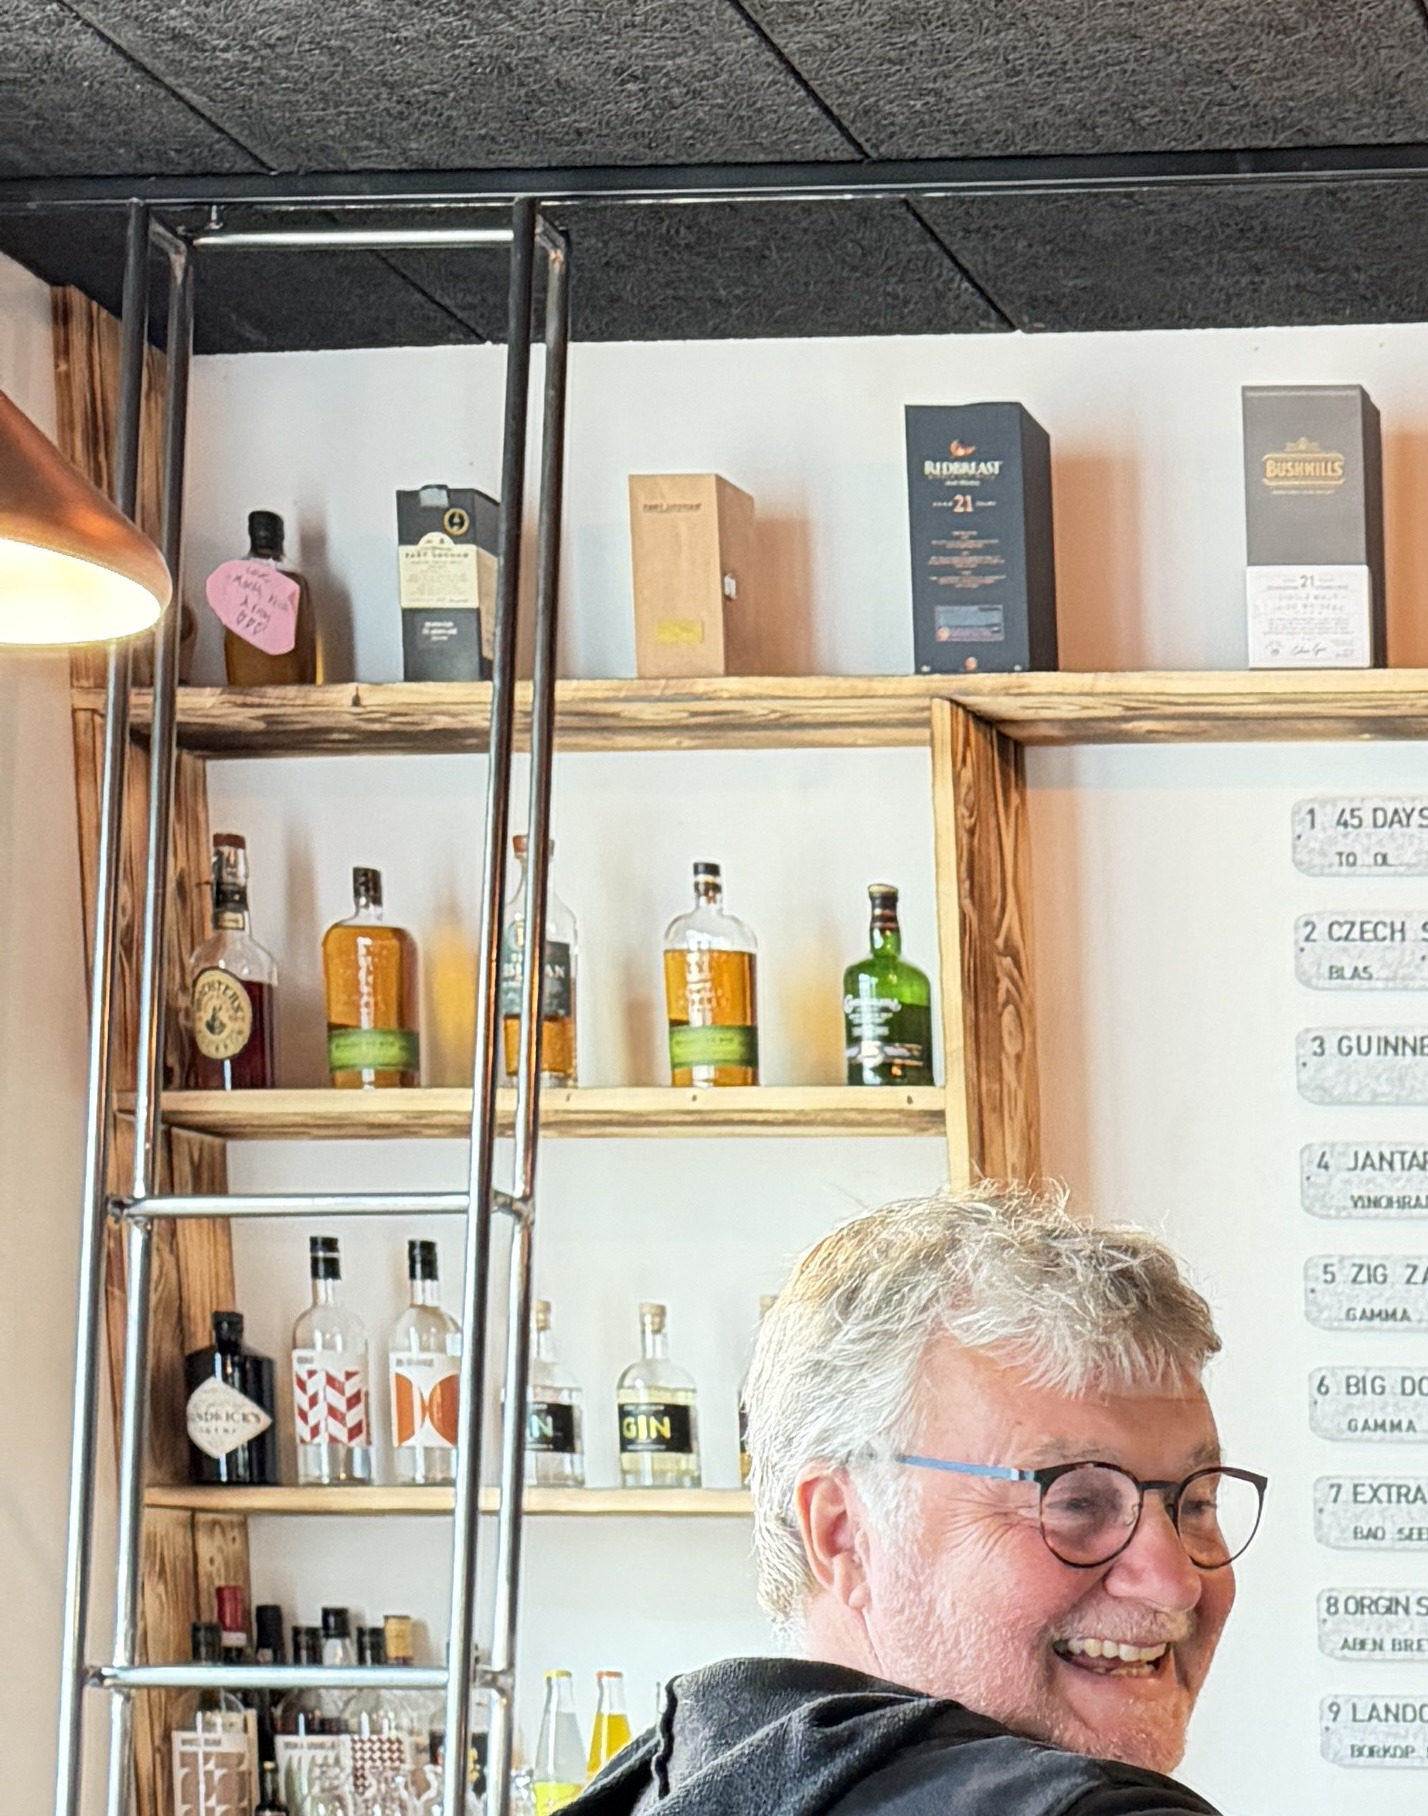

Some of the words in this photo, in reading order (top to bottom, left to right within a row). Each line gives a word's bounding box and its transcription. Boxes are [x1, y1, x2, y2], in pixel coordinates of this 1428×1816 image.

[952, 494, 974, 513] 21
[1300, 574, 1315, 588] 21
[1306, 807, 1316, 830] 1
[1335, 807, 1363, 830] 45
[1303, 920, 1317, 942] 2
[1327, 920, 1406, 943] CZECH
[1311, 1035, 1326, 1057] 3
[1316, 1150, 1330, 1172] 4
[1321, 1264, 1336, 1285] 5
[1351, 1264, 1388, 1286] ZIG
[1345, 1307, 1412, 1323] GAMMA
[1316, 1375, 1330, 1396] 6
[1345, 1375, 1387, 1397] BIG
[622, 1414, 671, 1440] GIN
[1347, 1418, 1418, 1434] GAMMA
[1329, 1484, 1342, 1504] 7
[1352, 1484, 1427, 1505] EXTRA
[1326, 1595, 1339, 1616] 8
[1344, 1595, 1410, 1616] ORGIN
[1328, 1701, 1341, 1722] 9
